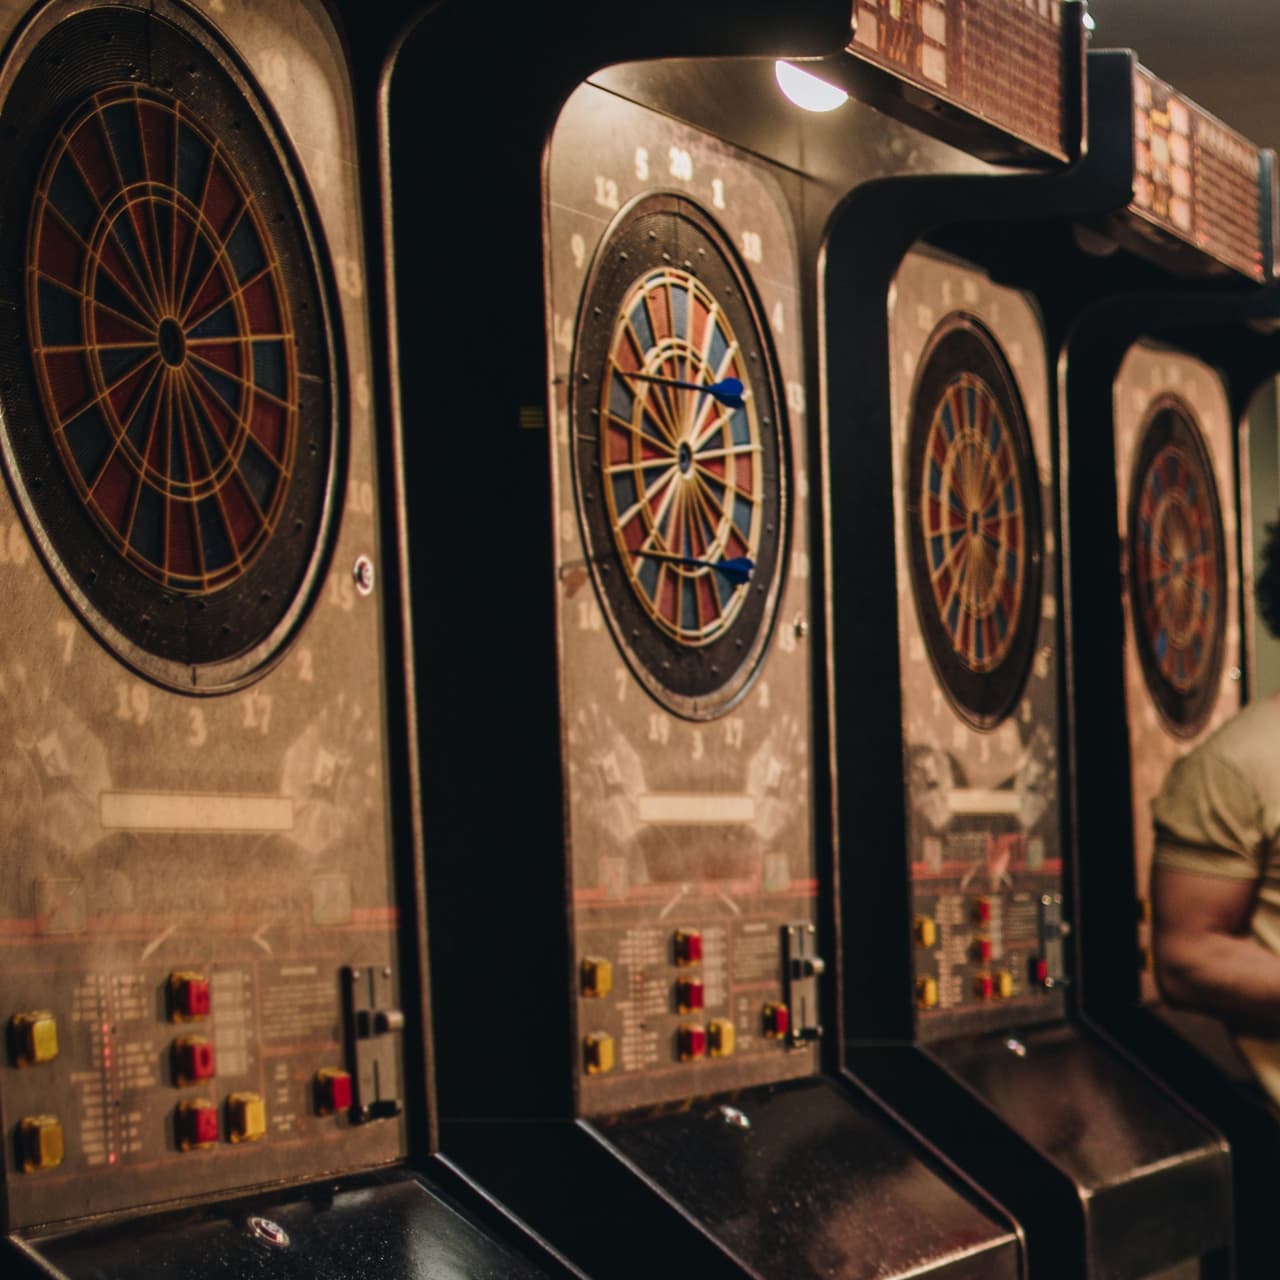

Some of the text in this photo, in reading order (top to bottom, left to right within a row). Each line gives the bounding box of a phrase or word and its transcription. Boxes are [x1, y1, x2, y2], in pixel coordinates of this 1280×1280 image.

[633, 146, 647, 182] 5
[669, 146, 692, 182] 20
[594, 176, 619, 210] 12
[710, 178, 724, 209] 1
[570, 233, 585, 269] 9
[56, 621, 76, 665] 7
[615, 667, 627, 702] 7
[115, 684, 150, 726] 19
[241, 693, 272, 737] 17
[188, 705, 207, 747] 3
[724, 717, 742, 749] 17
